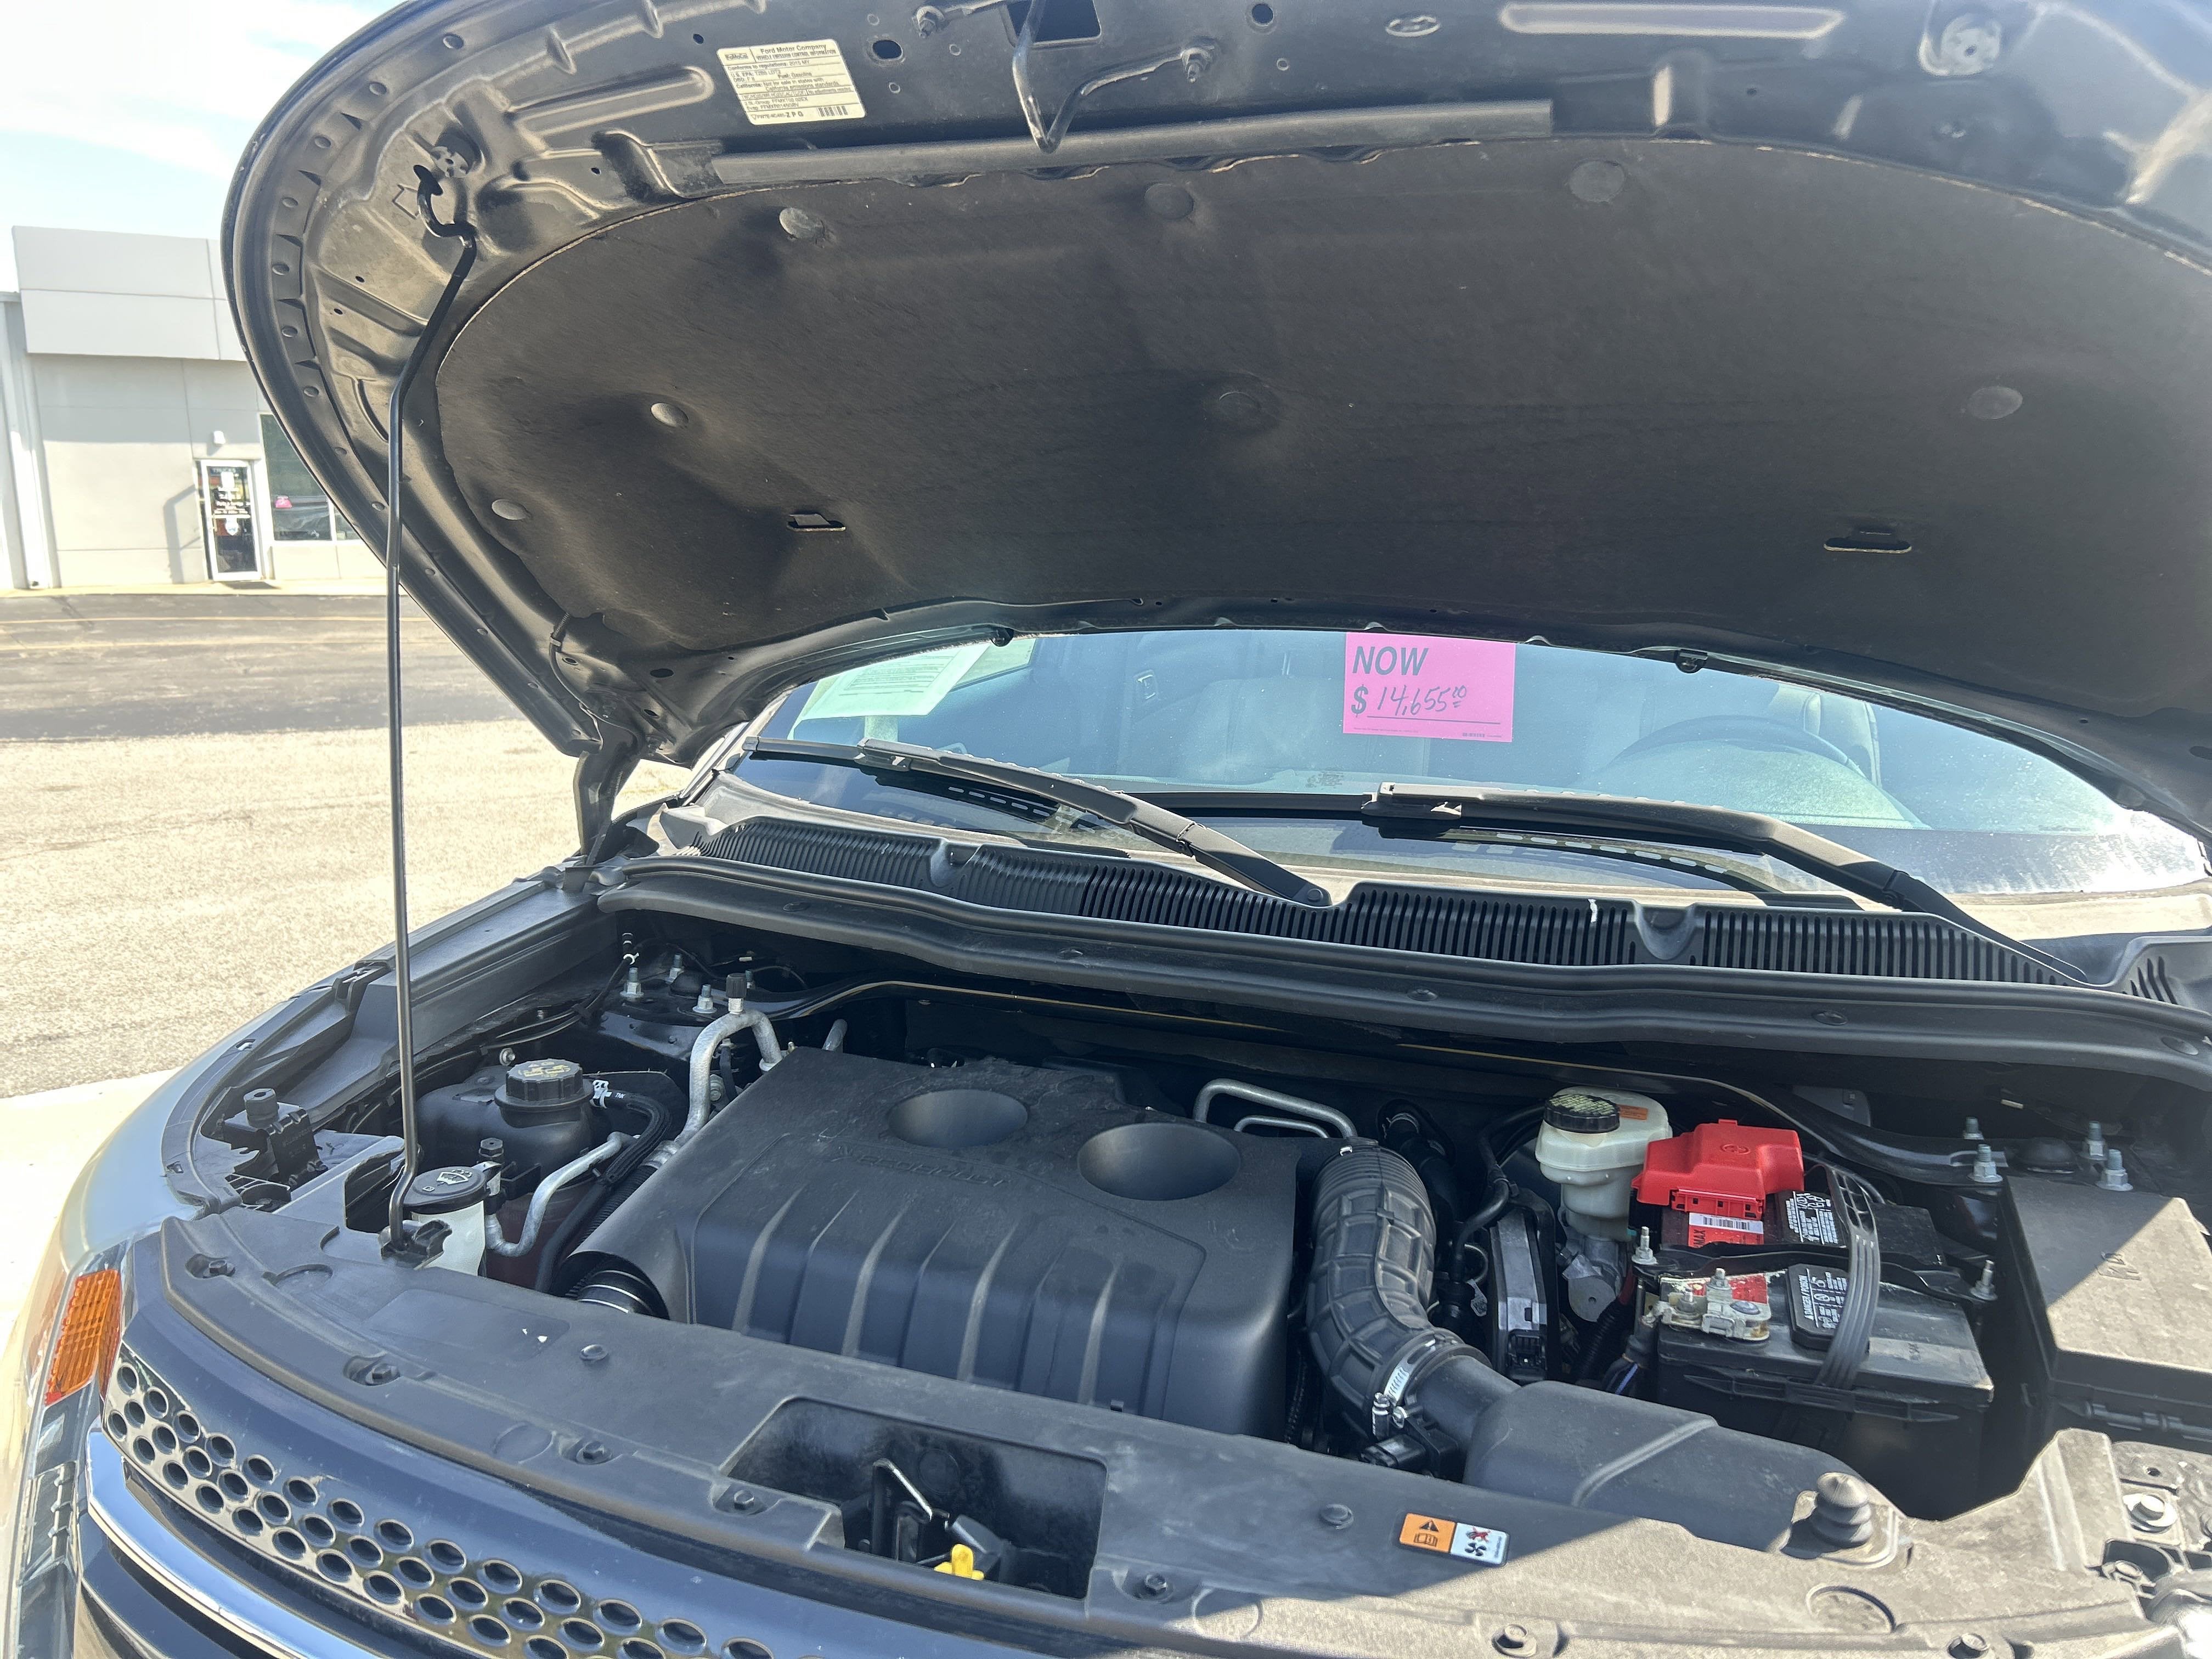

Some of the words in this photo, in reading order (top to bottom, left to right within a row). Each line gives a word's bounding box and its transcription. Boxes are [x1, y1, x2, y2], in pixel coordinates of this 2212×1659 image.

[795, 43, 827, 52] Company
[1352, 646, 1429, 676] NOW
[1351, 684, 1368, 718] $
